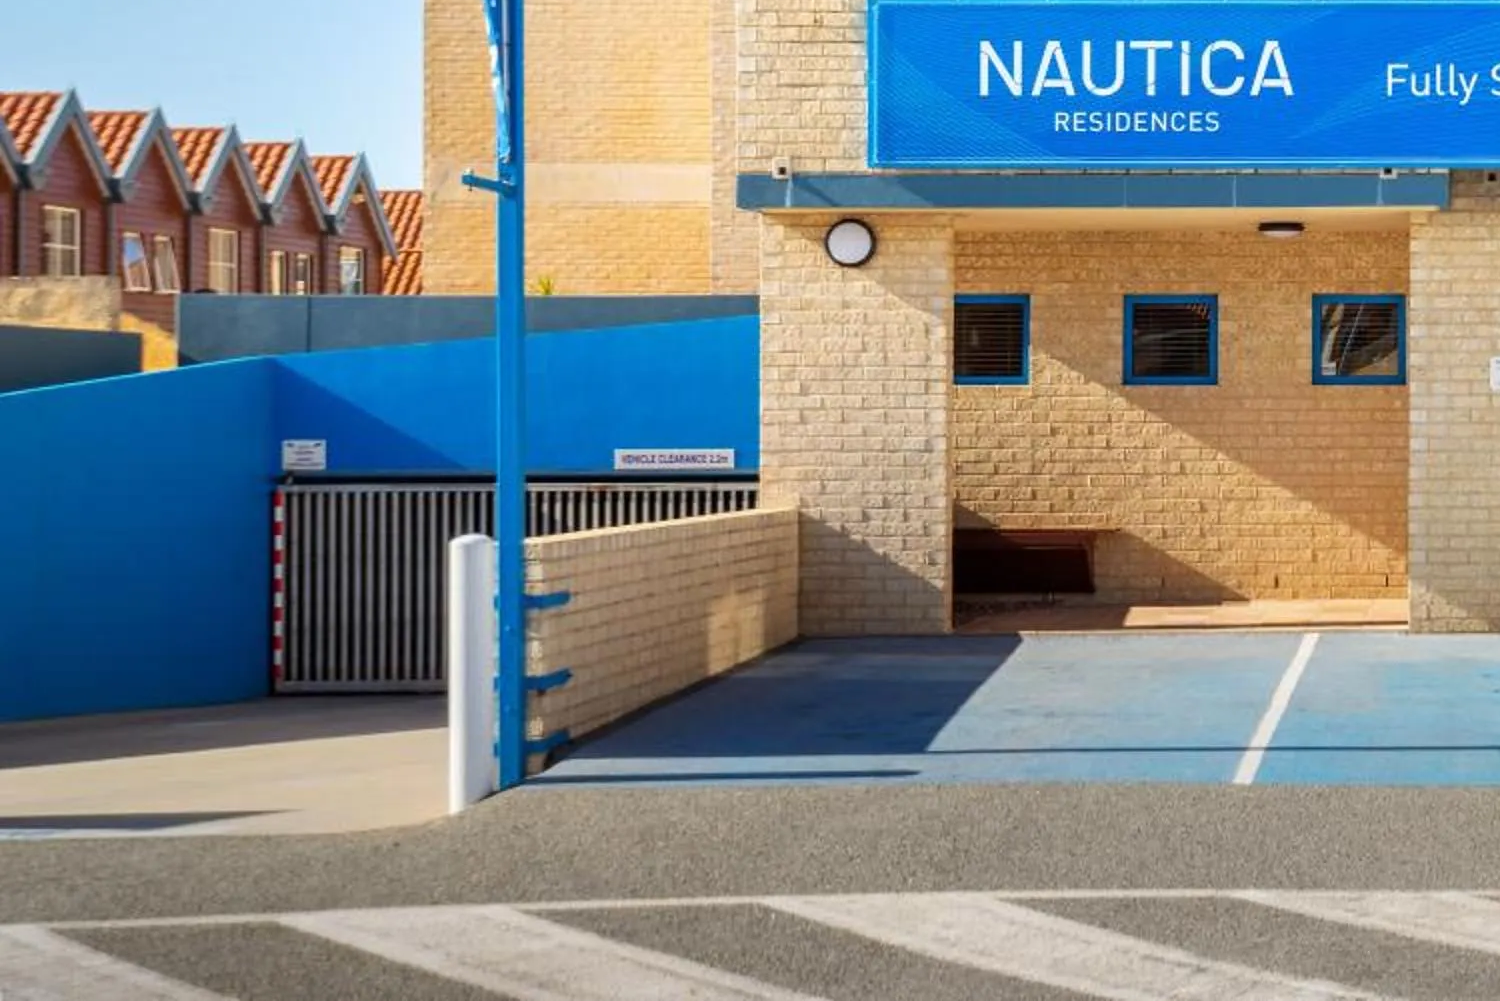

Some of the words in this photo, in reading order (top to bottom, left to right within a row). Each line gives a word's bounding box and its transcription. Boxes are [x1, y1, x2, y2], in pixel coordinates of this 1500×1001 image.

[979, 40, 1294, 96] NAUTICA
[1386, 63, 1477, 104] Fully
[1055, 112, 1219, 132] RESIDENCES
[658, 454, 707, 464] CLEARANCE
